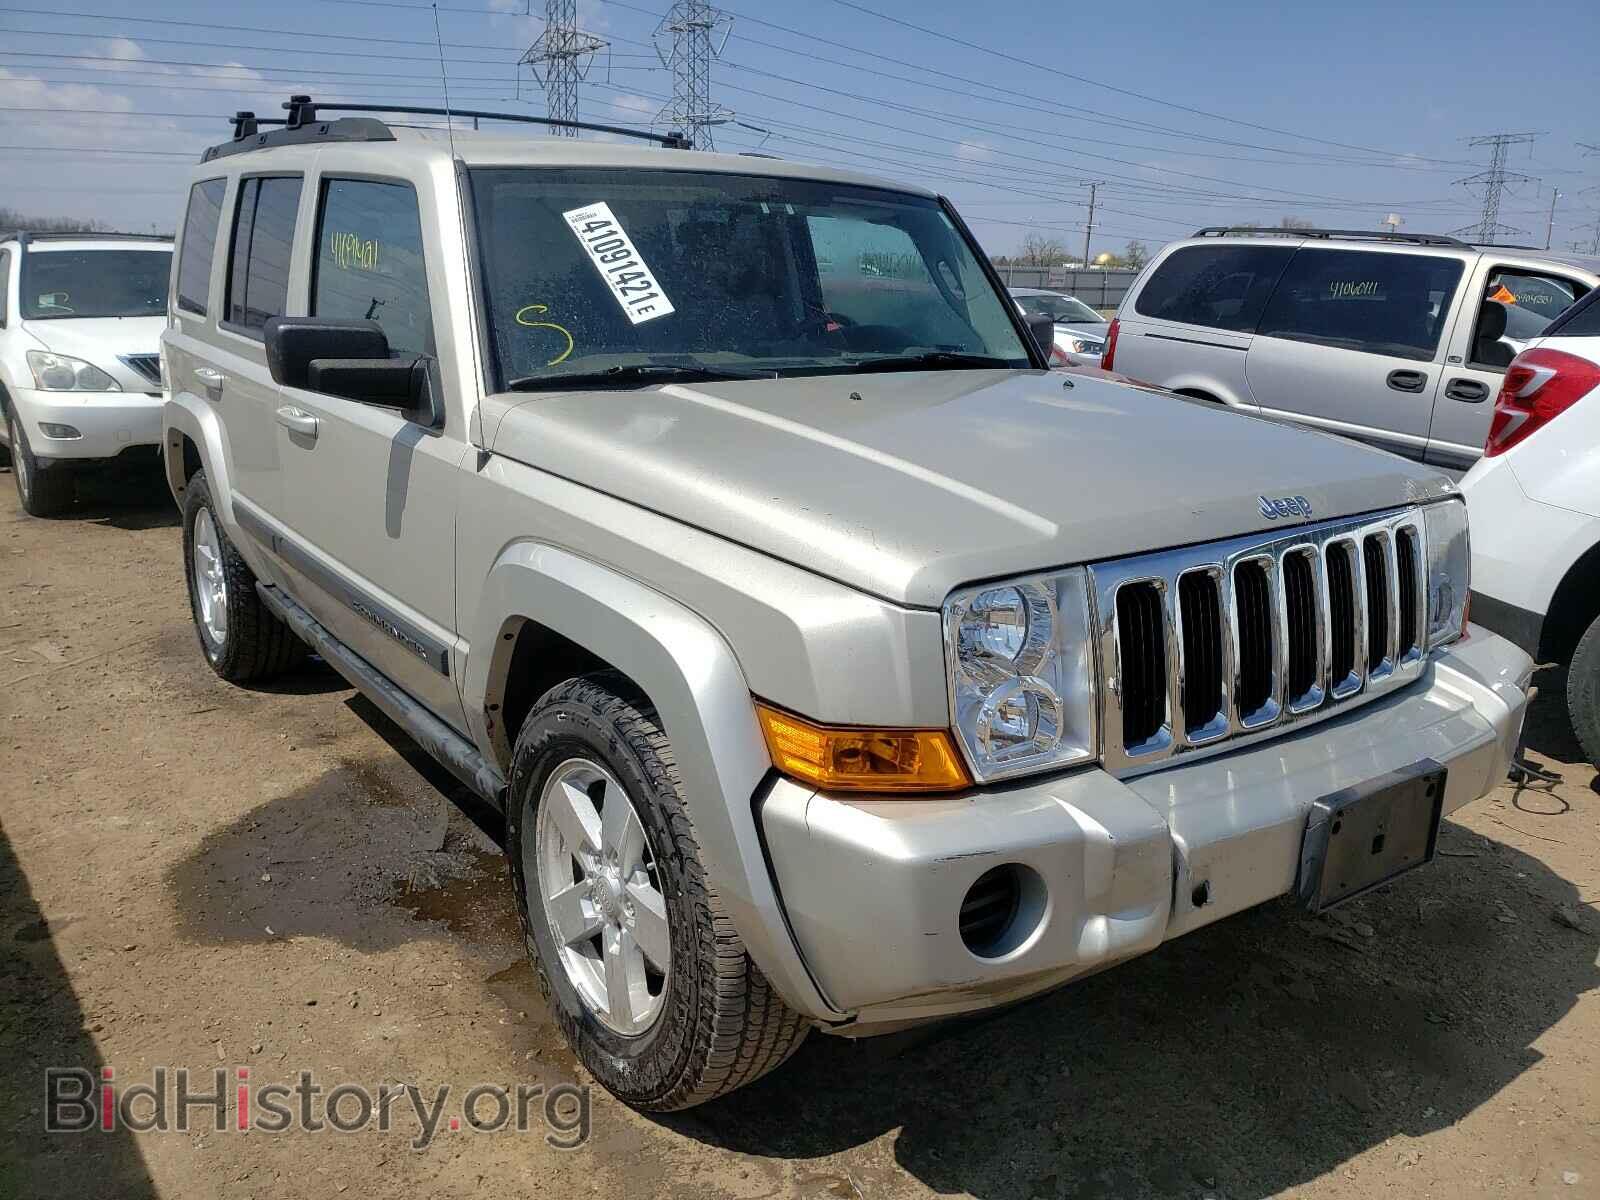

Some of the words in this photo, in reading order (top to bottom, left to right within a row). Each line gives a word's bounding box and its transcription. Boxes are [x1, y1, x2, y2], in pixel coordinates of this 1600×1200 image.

[582, 220, 659, 305] 41091421
[637, 304, 655, 315] E
[516, 305, 574, 366] S
[1256, 495, 1313, 520] Jeep
